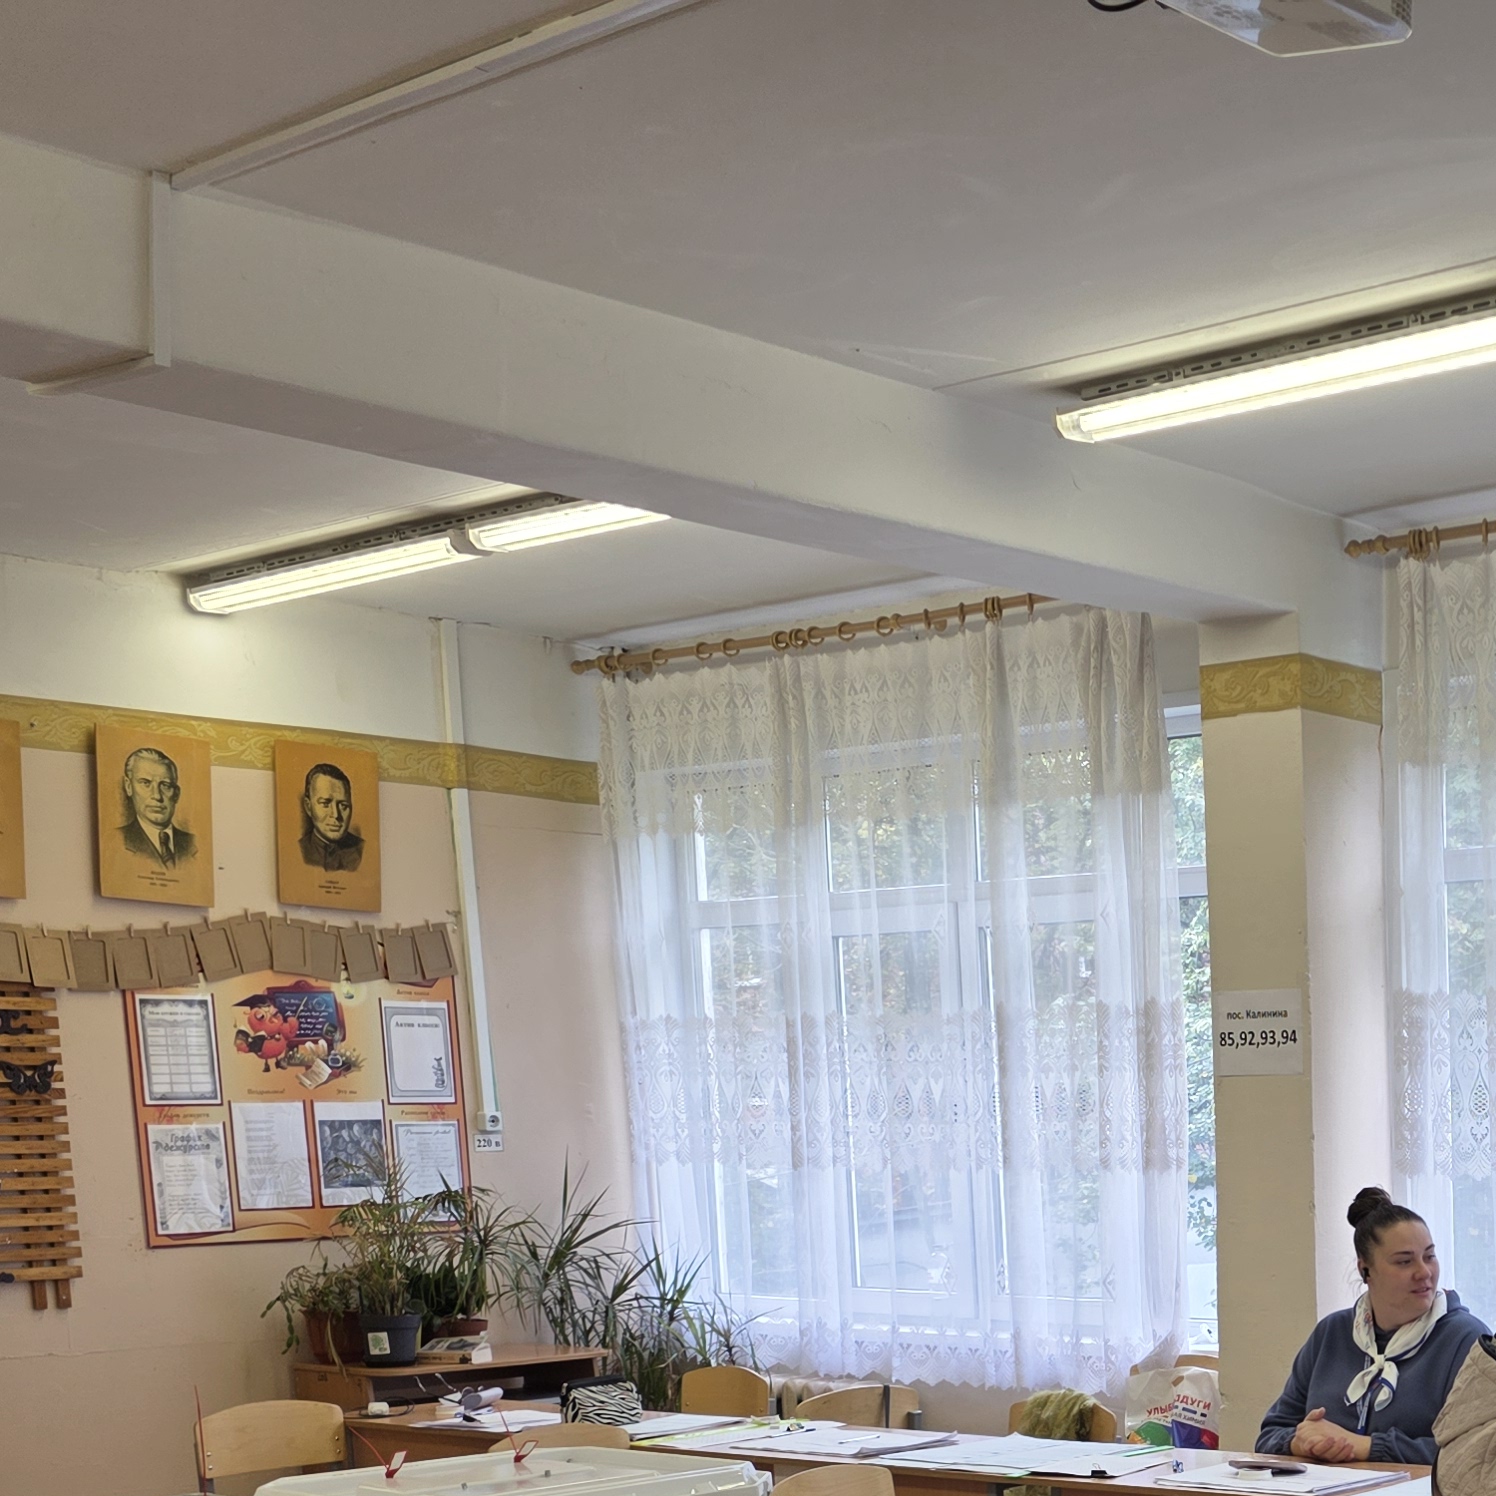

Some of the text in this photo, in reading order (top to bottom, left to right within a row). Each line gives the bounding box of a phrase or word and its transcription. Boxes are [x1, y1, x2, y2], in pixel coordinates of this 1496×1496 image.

[1226, 1009, 1288, 1020] пос. Калинина
[1219, 1029, 1298, 1050] 85,92,93,94
[476, 1138, 493, 1148] 220
[1146, 1403, 1175, 1417] УЛЫБ
